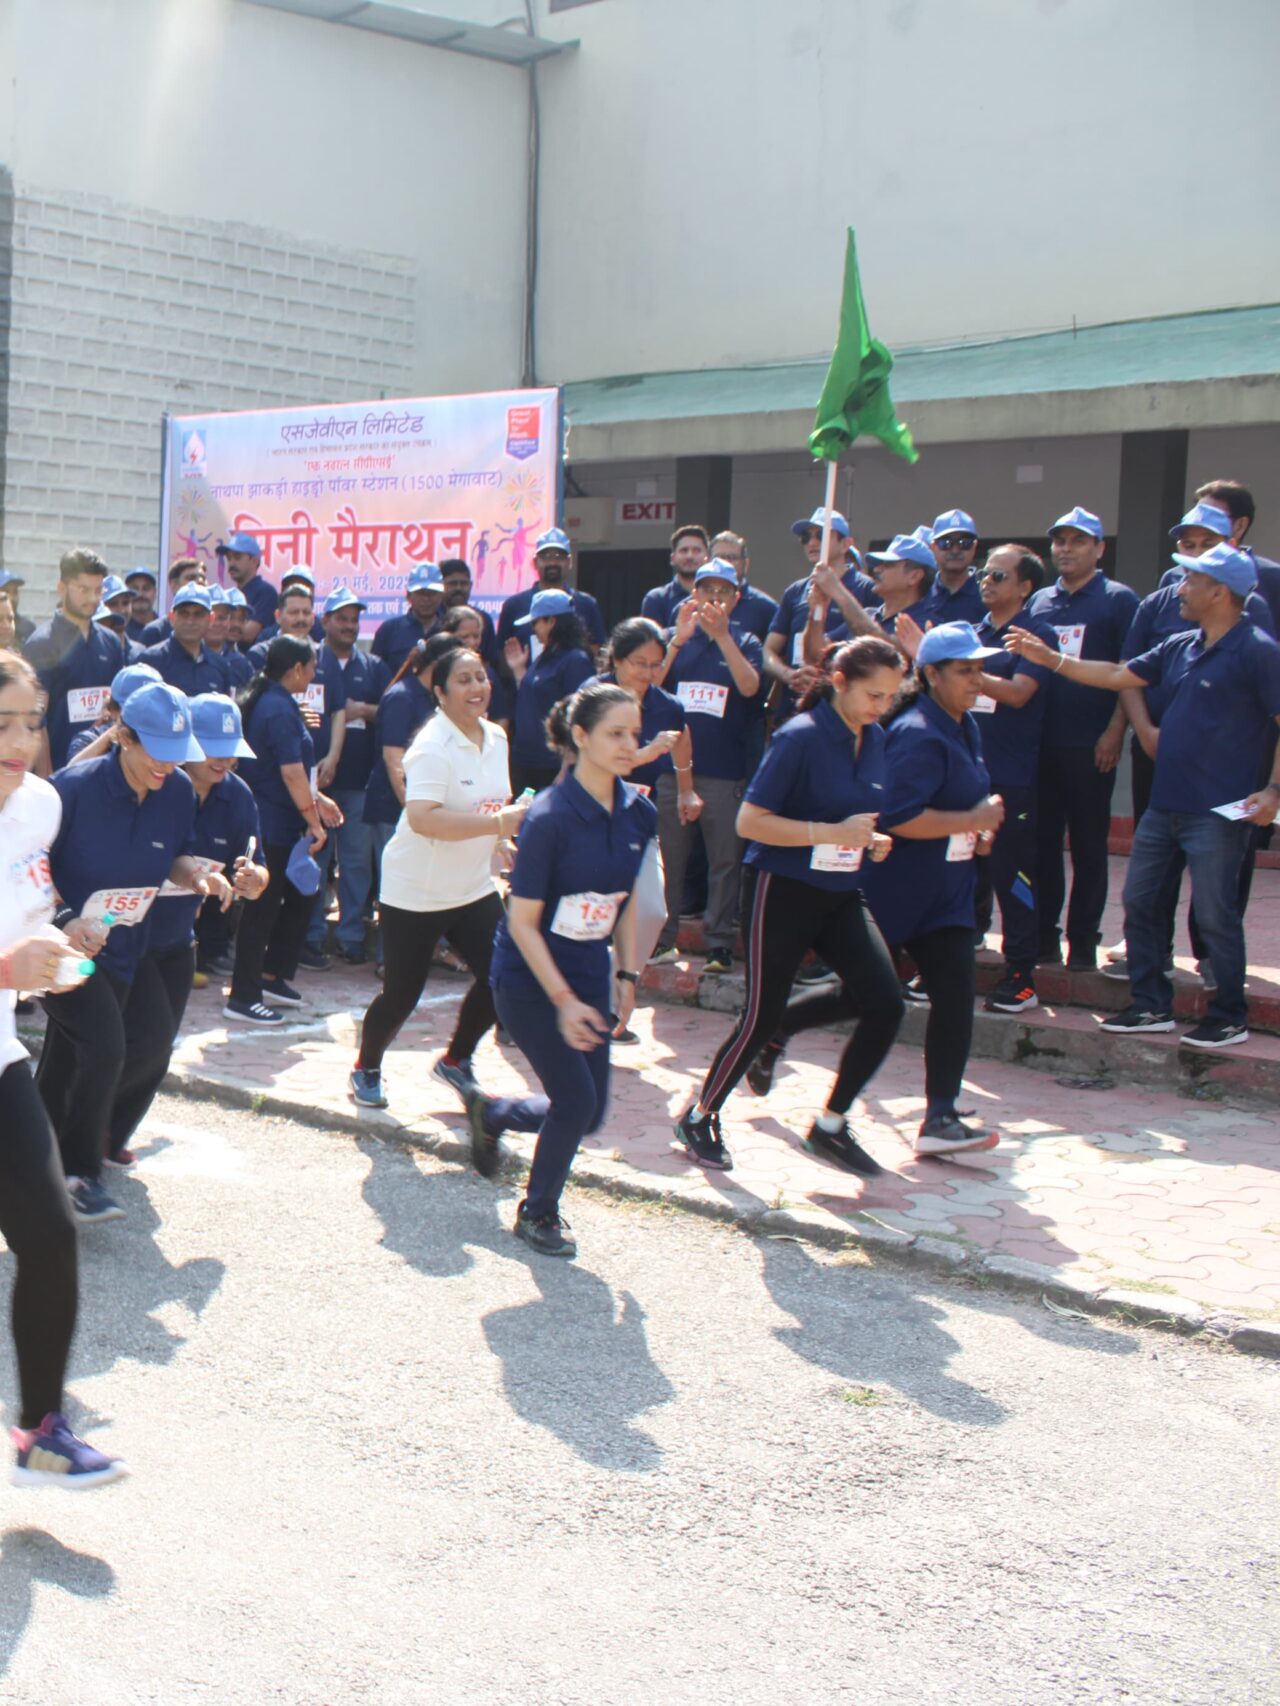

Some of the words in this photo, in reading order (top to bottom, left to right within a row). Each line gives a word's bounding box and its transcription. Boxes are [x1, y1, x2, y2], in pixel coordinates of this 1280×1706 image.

[281, 416, 357, 444] एसजेवीएन
[362, 411, 425, 436] लिमिटेड
[622, 502, 676, 520] EXIT
[327, 506, 474, 567] मैराथन
[81, 694, 100, 707] 167
[689, 688, 713, 701] 111
[104, 896, 140, 911] 155
